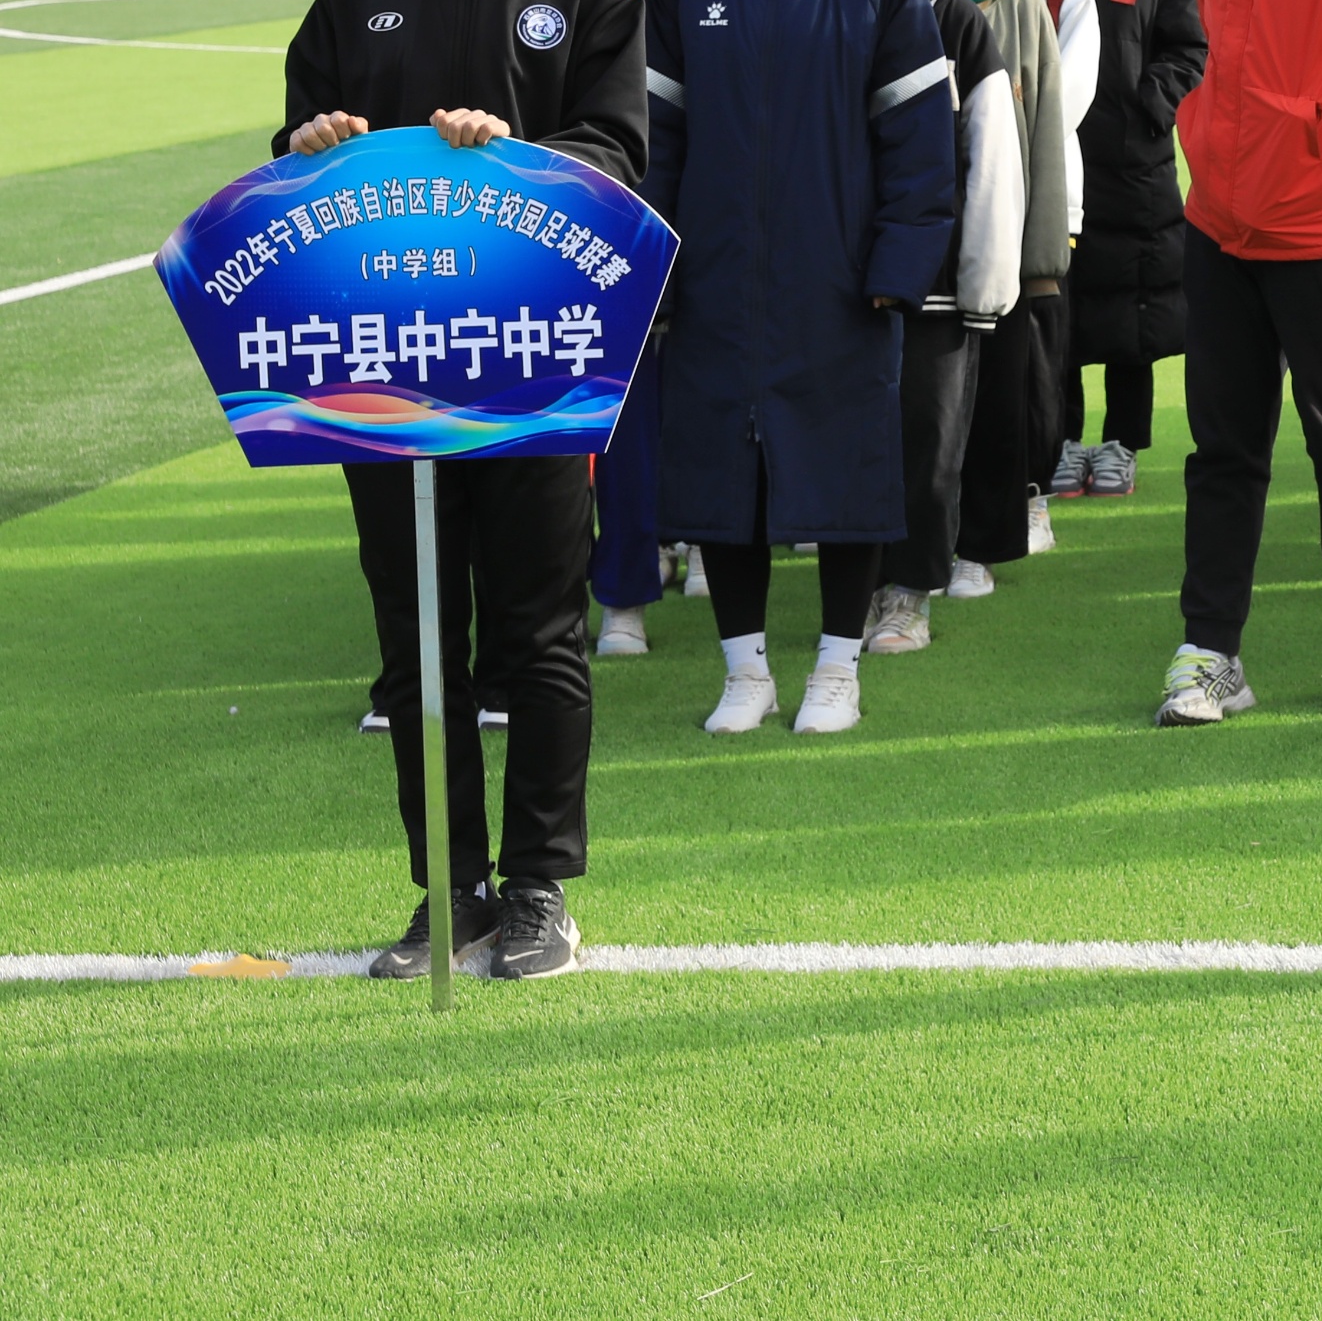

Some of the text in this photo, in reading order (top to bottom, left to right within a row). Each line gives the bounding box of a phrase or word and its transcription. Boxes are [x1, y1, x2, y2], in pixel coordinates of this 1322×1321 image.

[204, 177, 632, 306] 2022年宁夏回族自治区青少年校园足球联赛
[238, 303, 604, 388] 中宁县中宁中学
